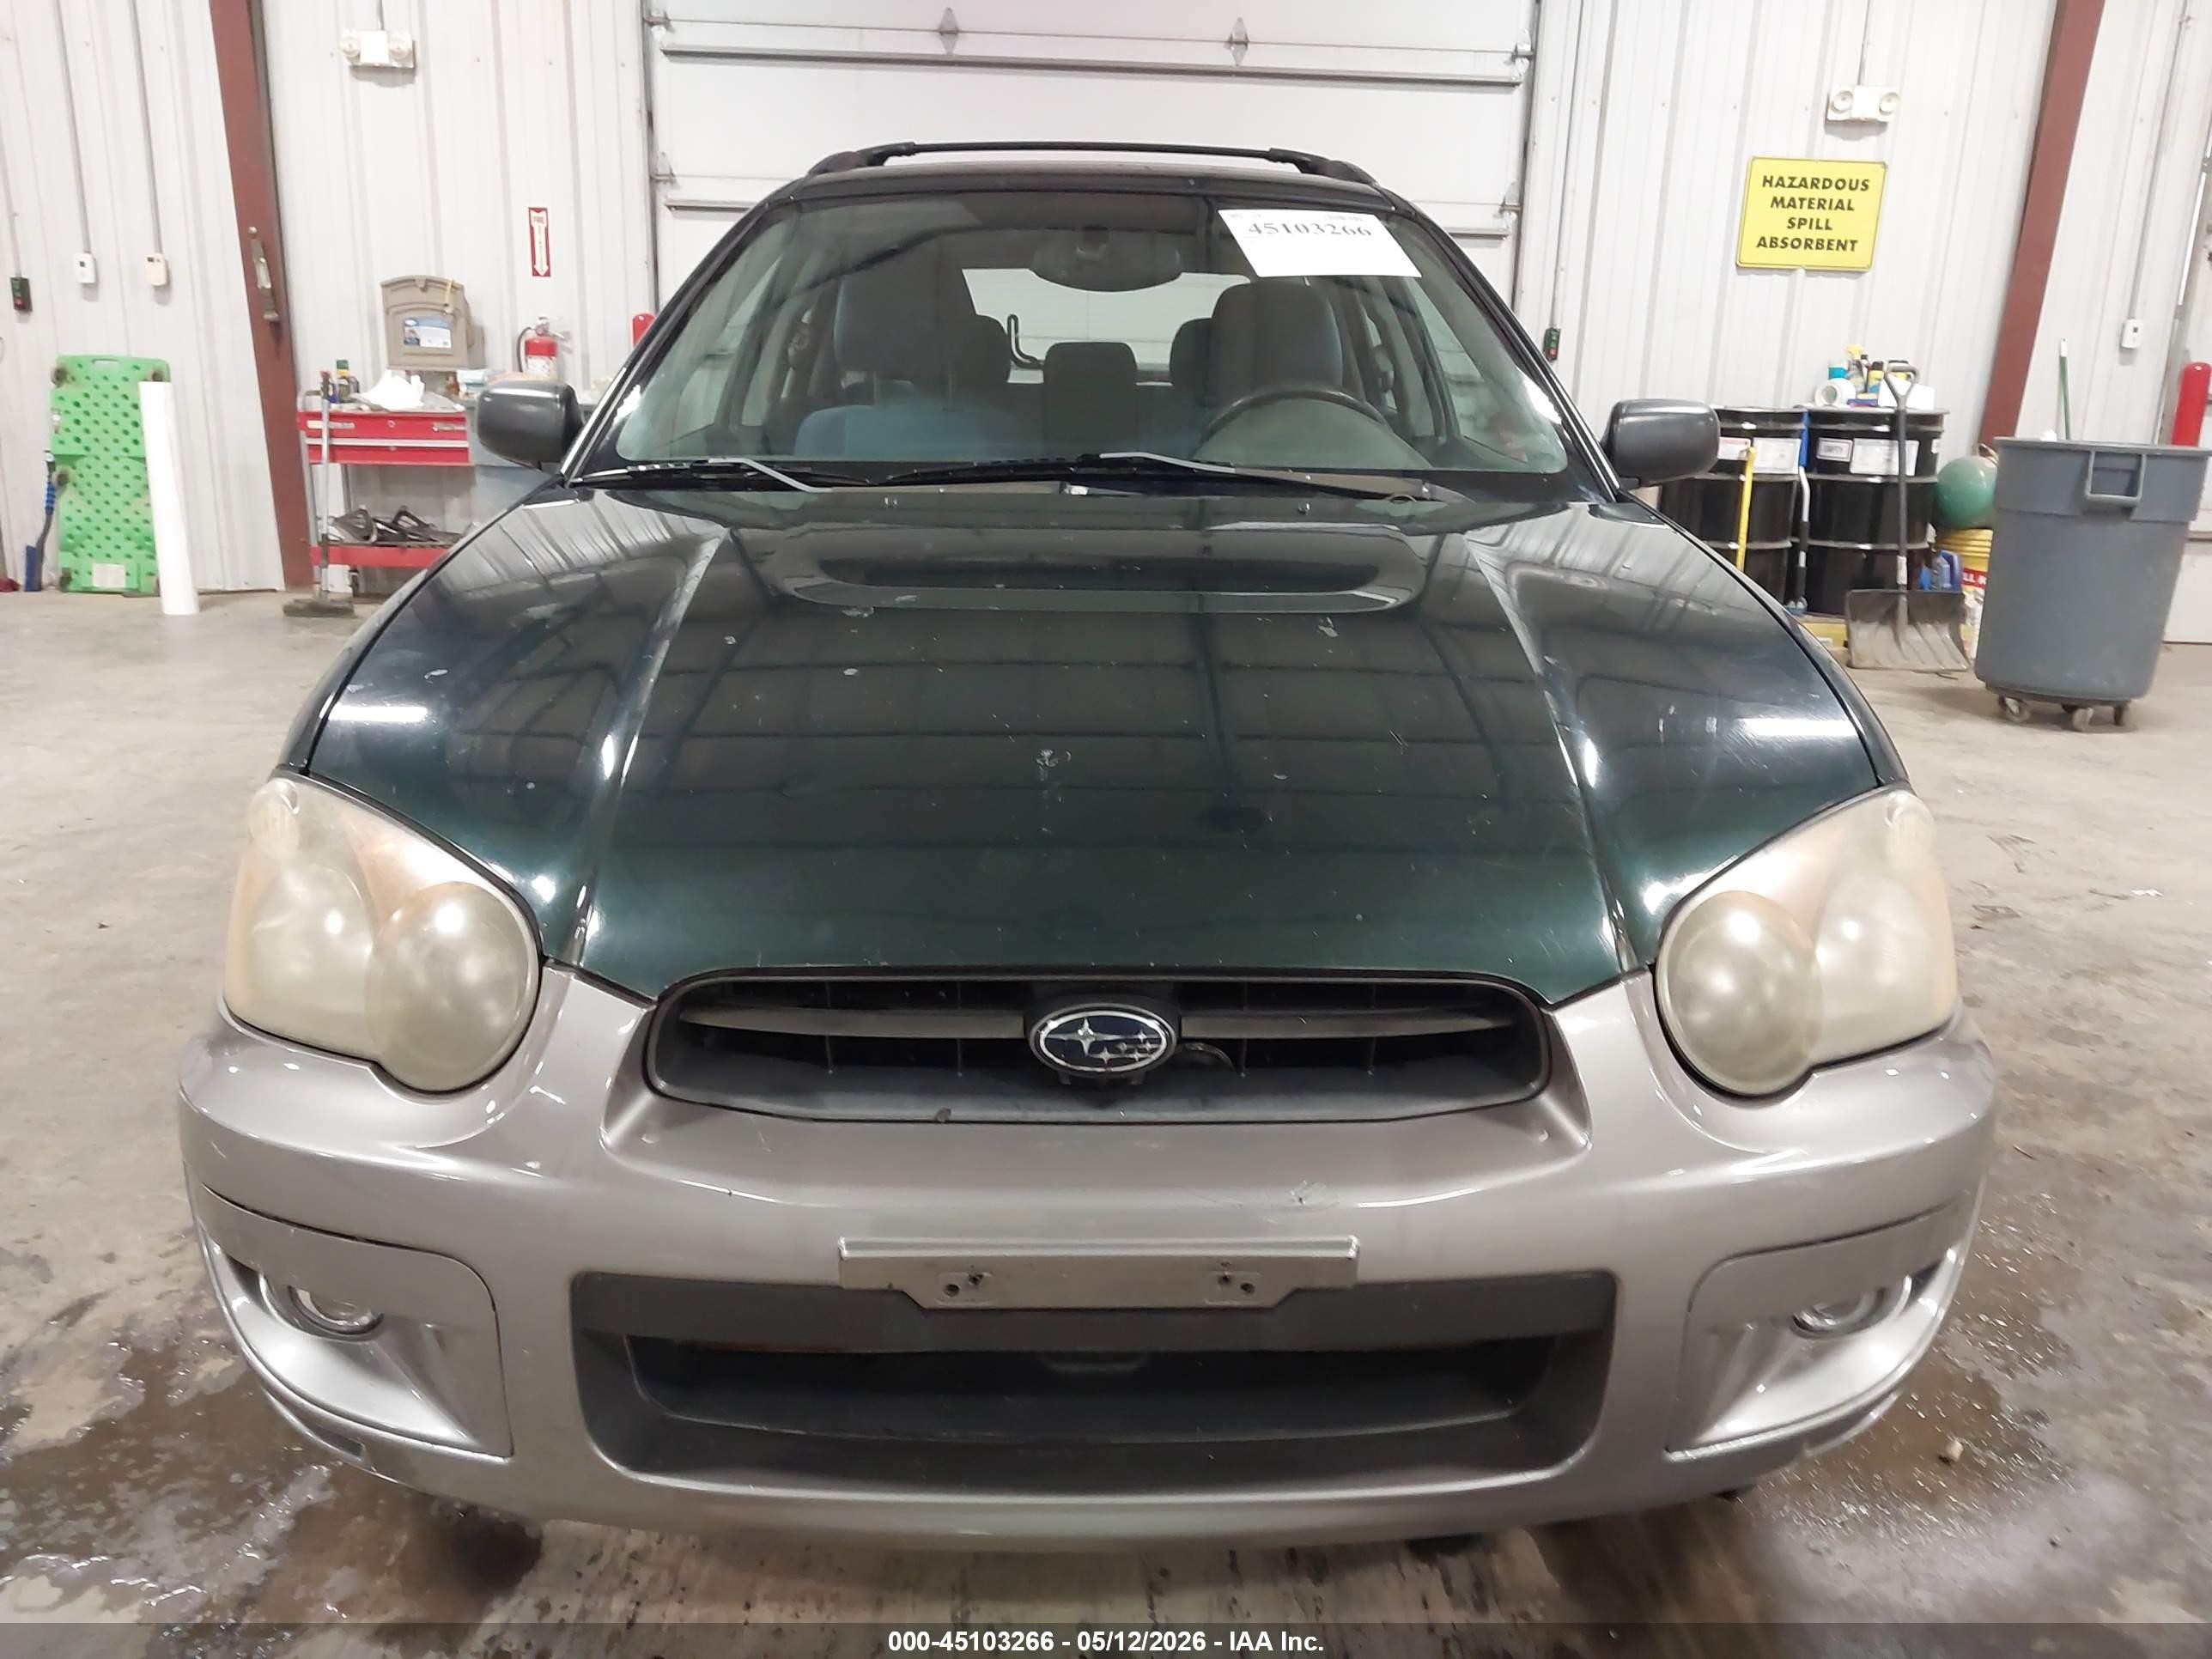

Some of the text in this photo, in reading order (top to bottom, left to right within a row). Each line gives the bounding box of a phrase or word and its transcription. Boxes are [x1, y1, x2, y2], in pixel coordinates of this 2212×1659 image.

[1762, 175, 1870, 191] HAZARDOUS
[1770, 197, 1855, 211] MATERIAL
[1249, 222, 1372, 236] 45103266
[1786, 217, 1833, 231] SPILL
[1756, 236, 1858, 252] ABSORBENT
